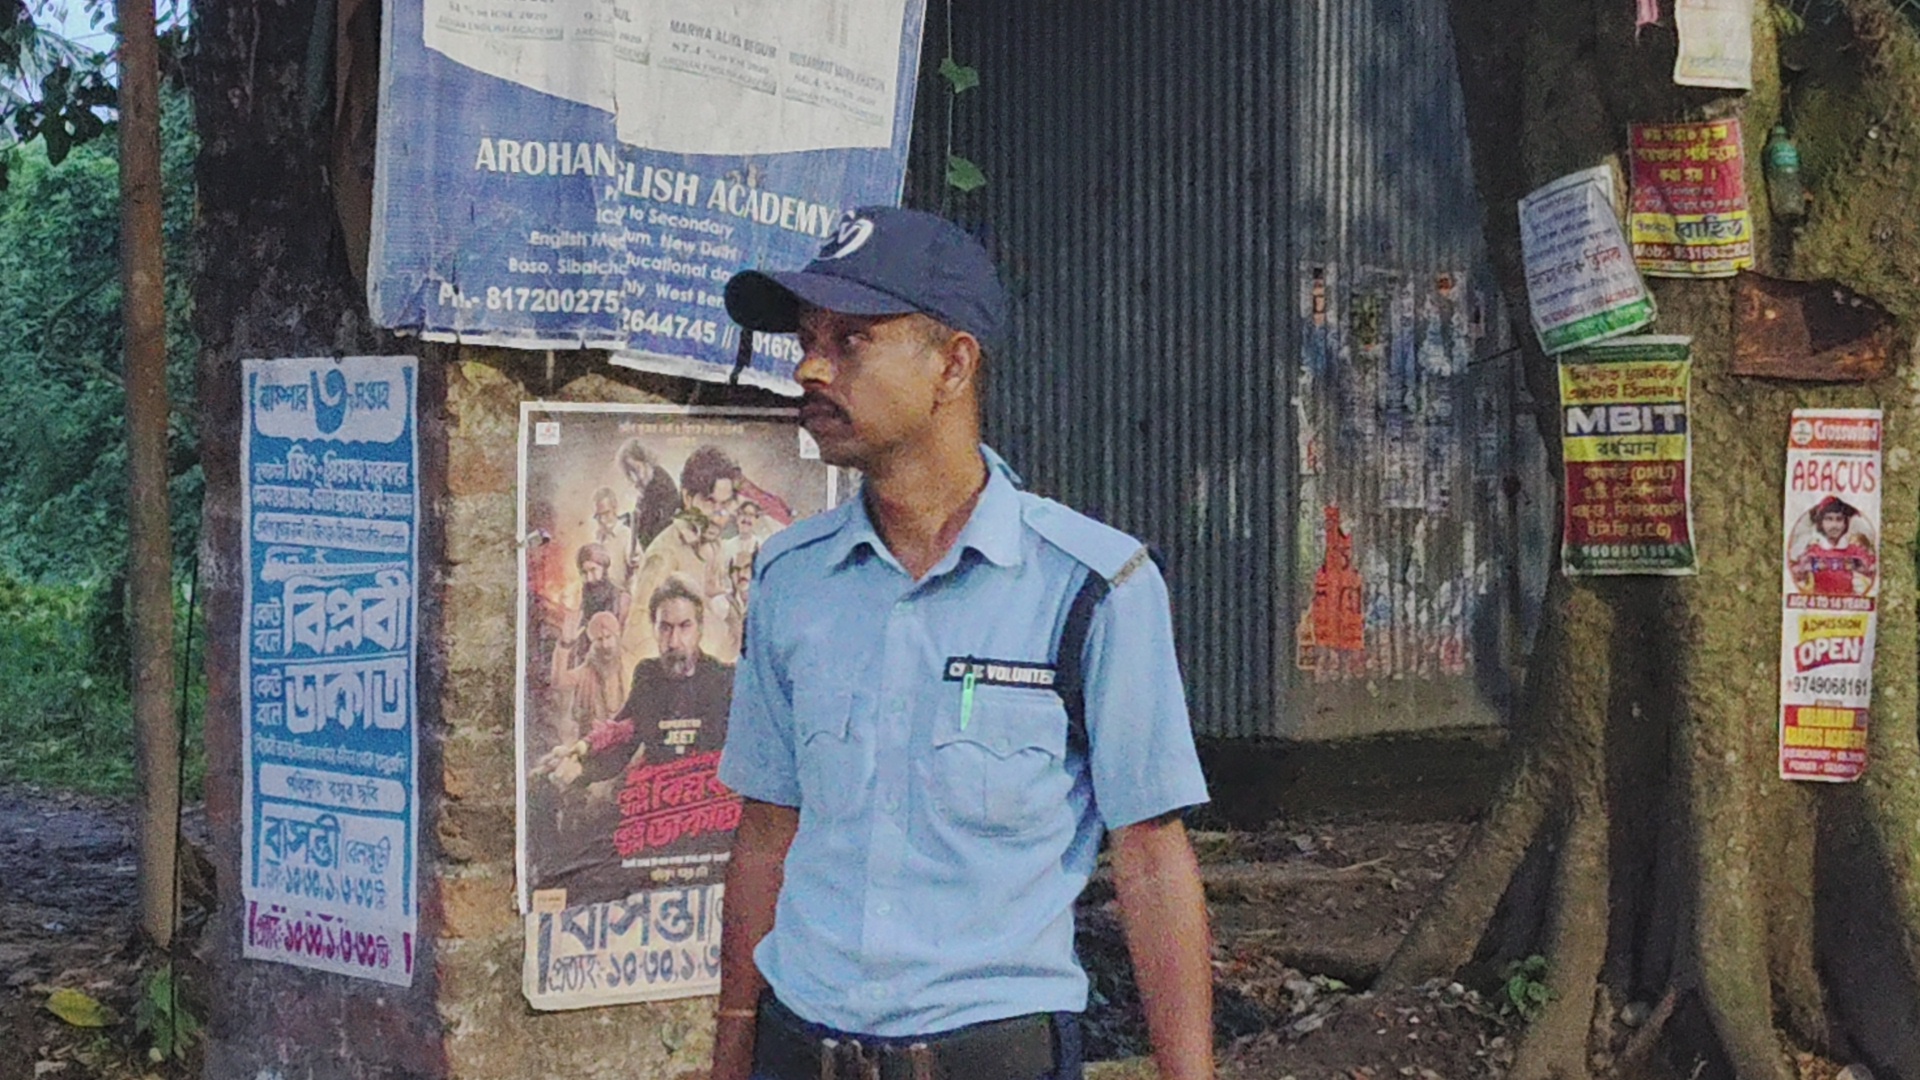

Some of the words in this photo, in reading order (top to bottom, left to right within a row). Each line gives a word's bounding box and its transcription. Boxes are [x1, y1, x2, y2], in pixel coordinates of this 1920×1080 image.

[475, 138, 616, 177] AROHAN
[706, 178, 837, 238] ACADEMY
[649, 208, 734, 239] Secondary
[529, 230, 587, 248] English
[656, 282, 694, 302] West
[1567, 405, 1685, 433] MBIT
[1814, 420, 1877, 441] Crosswind
[1792, 460, 1876, 493] ABACUS
[283, 569, 411, 655] বিপ্লবী
[1803, 618, 1862, 633] ADMISSION
[1799, 637, 1860, 666] OPEN
[254, 668, 283, 697] কেউ
[987, 664, 1056, 685] VOLUNTEER
[285, 658, 408, 734] ডাকাত
[254, 702, 283, 726] বলে
[664, 730, 698, 746] JEET
[264, 813, 341, 870] বাসন্তী
